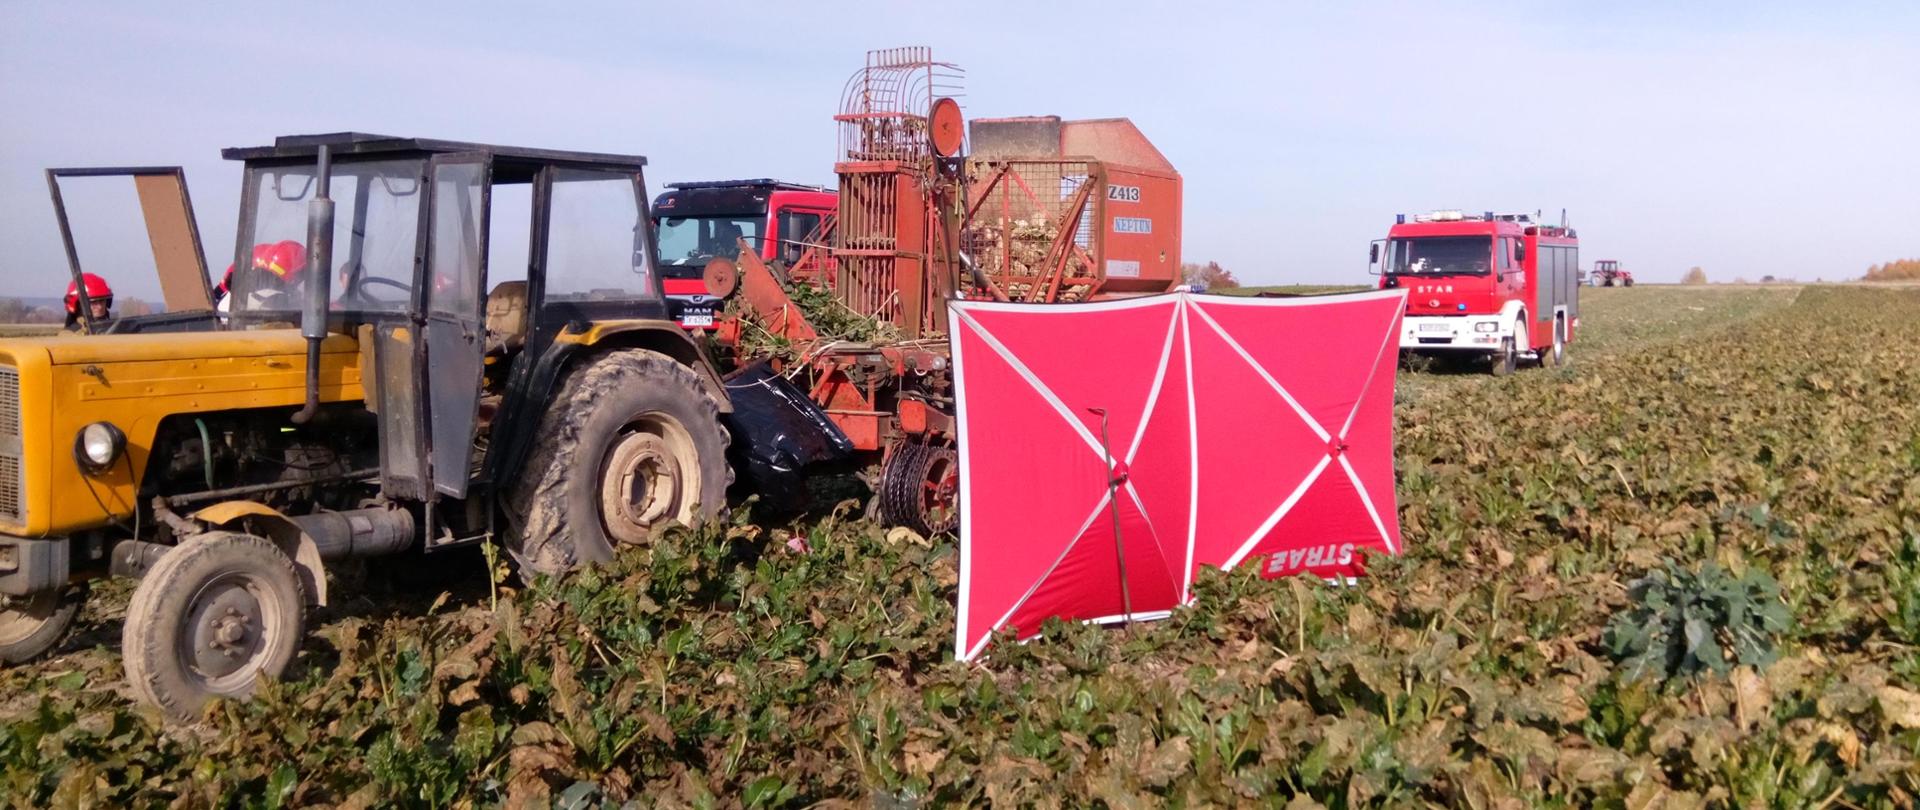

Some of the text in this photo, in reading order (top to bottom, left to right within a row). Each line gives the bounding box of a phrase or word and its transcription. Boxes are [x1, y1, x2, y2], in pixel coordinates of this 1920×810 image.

[1108, 185, 1140, 201] Z413
[1114, 218, 1151, 232] NEPTUN
[1417, 285, 1453, 294] STAR
